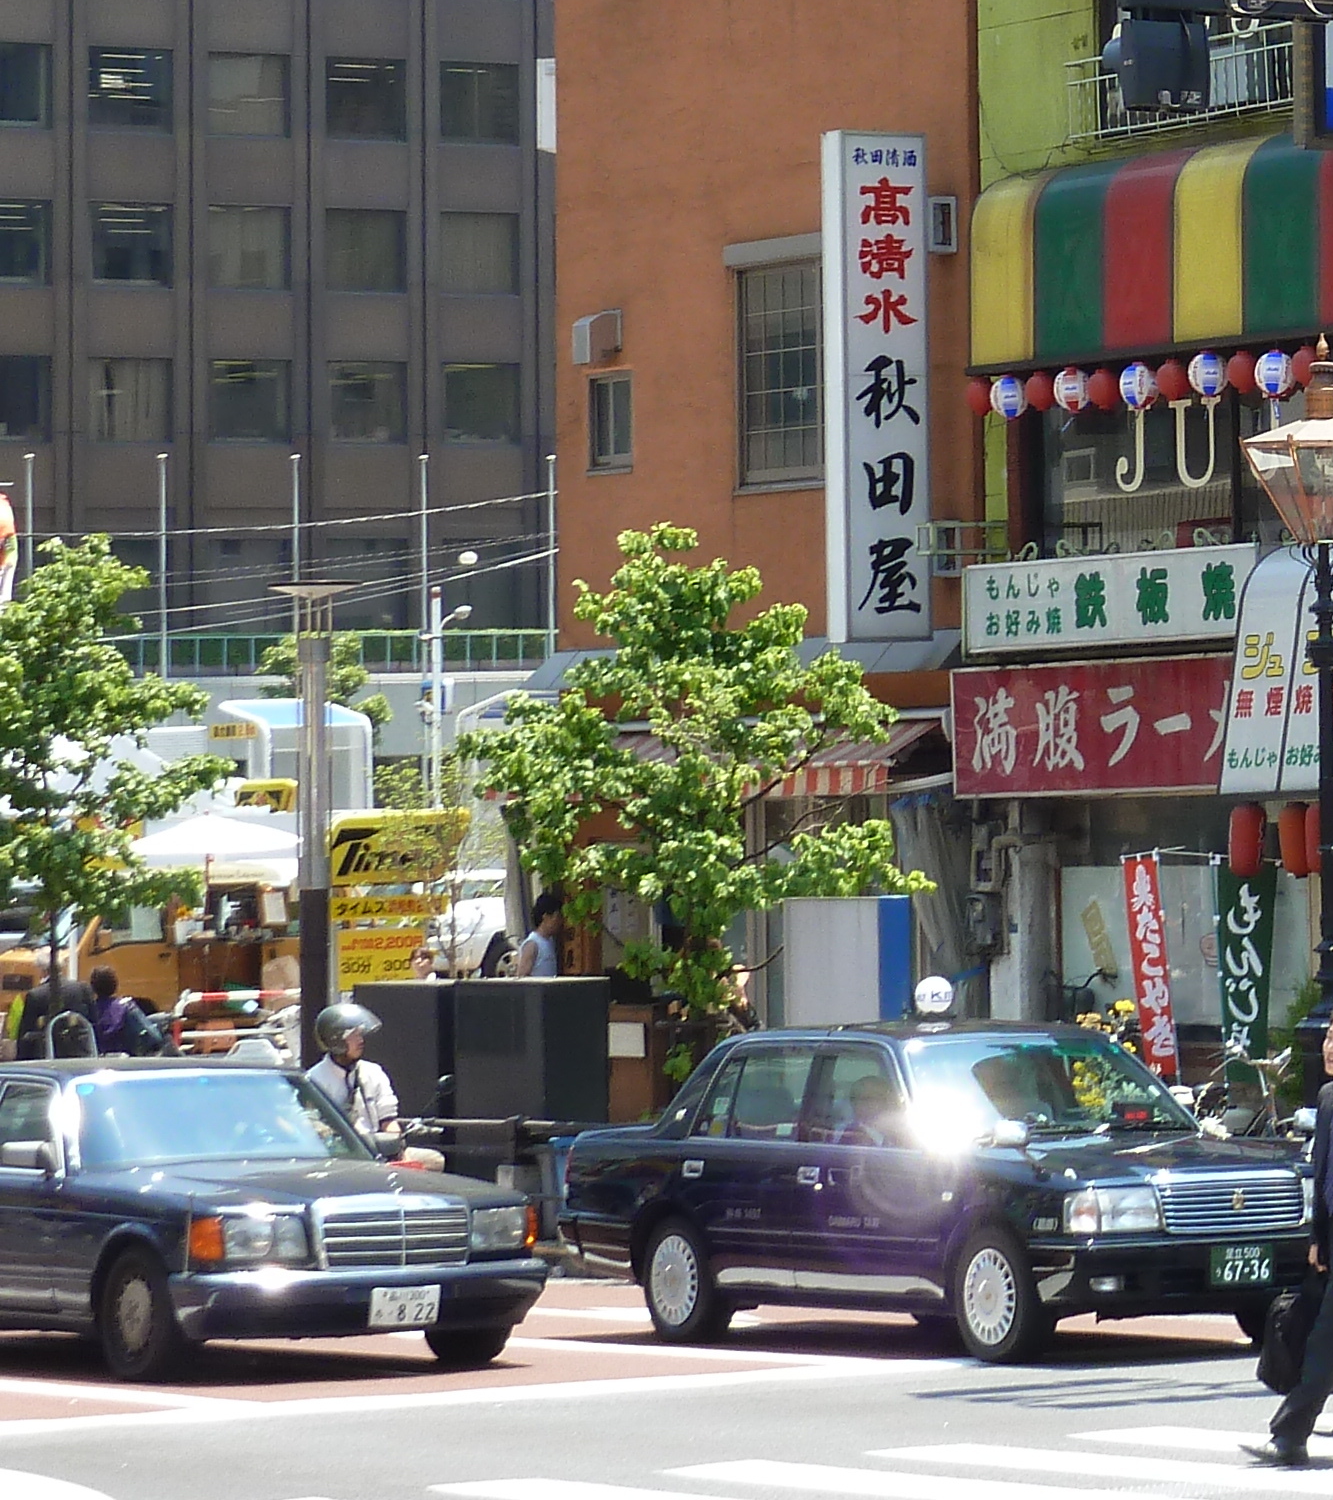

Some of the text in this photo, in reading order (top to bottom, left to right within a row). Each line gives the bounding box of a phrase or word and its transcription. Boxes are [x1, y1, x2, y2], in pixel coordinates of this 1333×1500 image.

[852, 147, 918, 168] 秋田清酒
[855, 353, 922, 617] 秋田屋
[985, 561, 1237, 629] もんじゃ 鉄板焼
[985, 606, 1062, 637] お好み焼
[1241, 631, 1285, 680] ジュ
[1226, 747, 1278, 770] もんじゃ
[1223, 1258, 1270, 1281] 67-36
